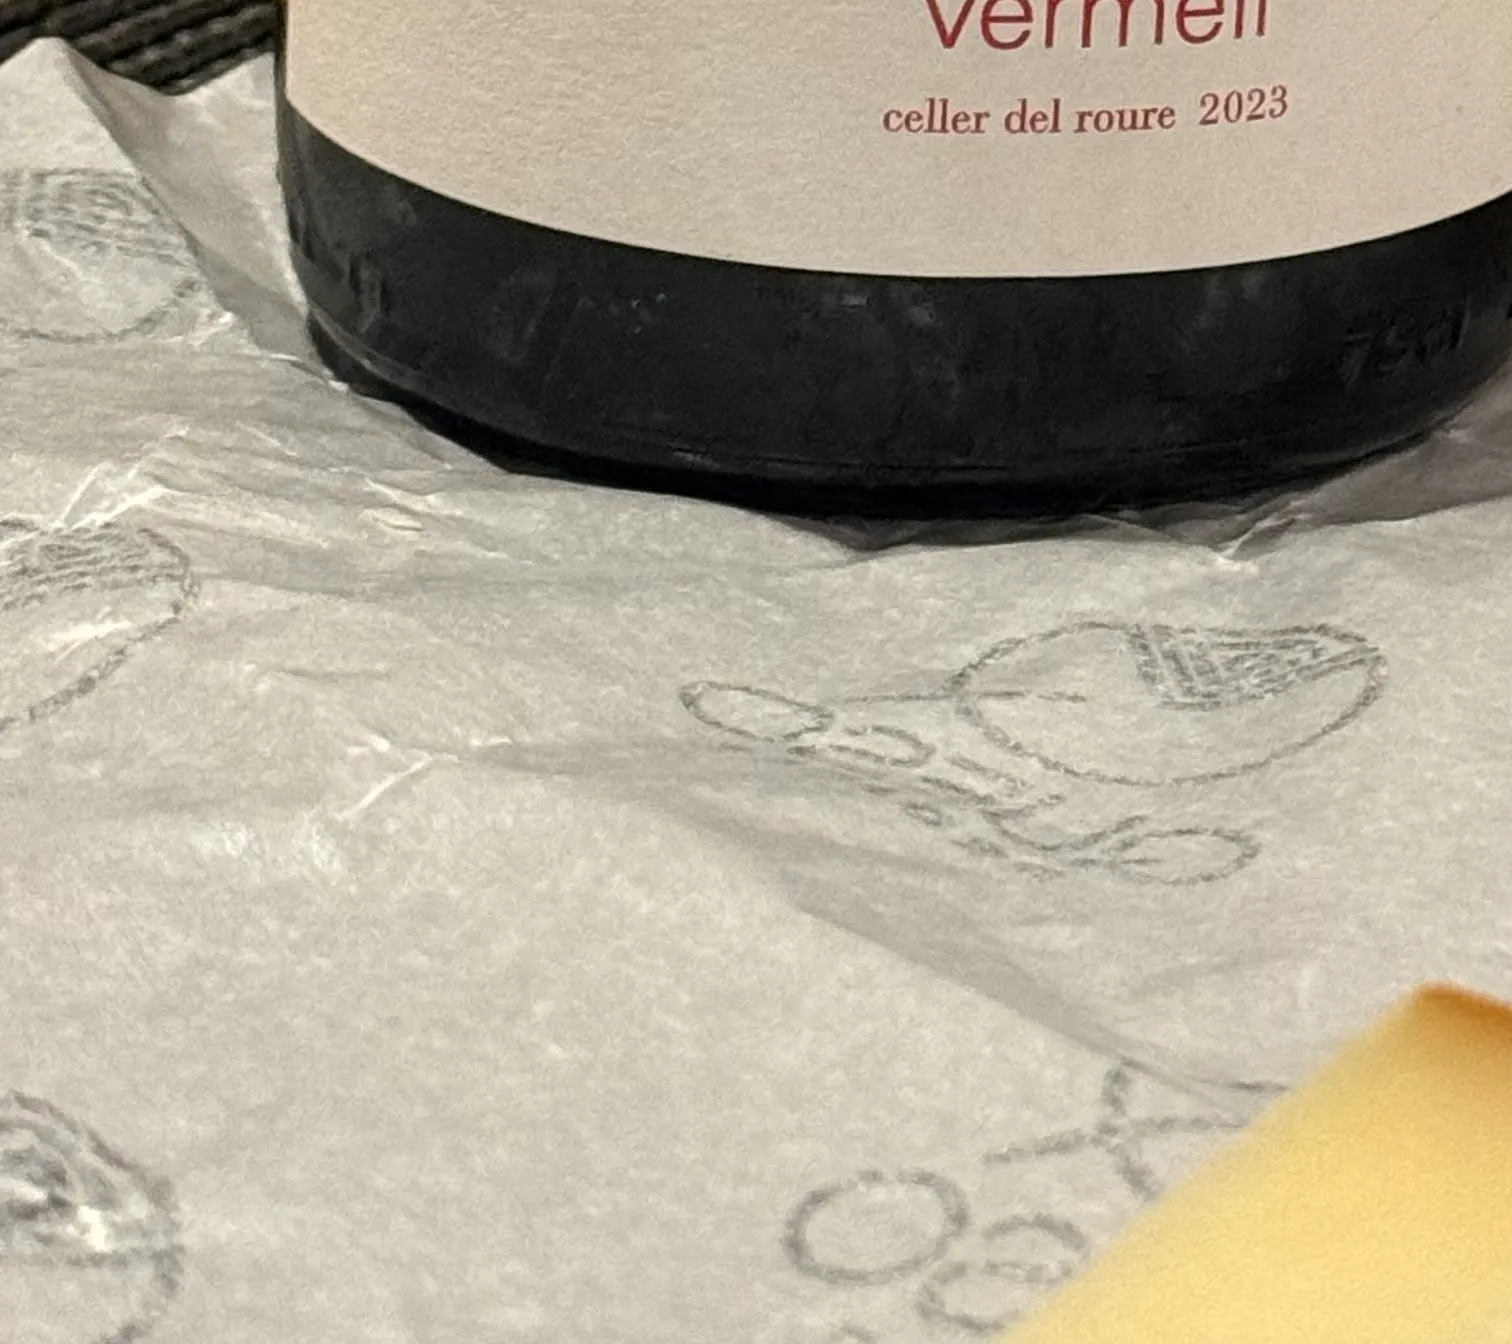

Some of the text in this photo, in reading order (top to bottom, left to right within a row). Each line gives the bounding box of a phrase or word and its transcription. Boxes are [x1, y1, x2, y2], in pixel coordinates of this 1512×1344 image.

[882, 83, 1289, 135] celler del roure 2023
